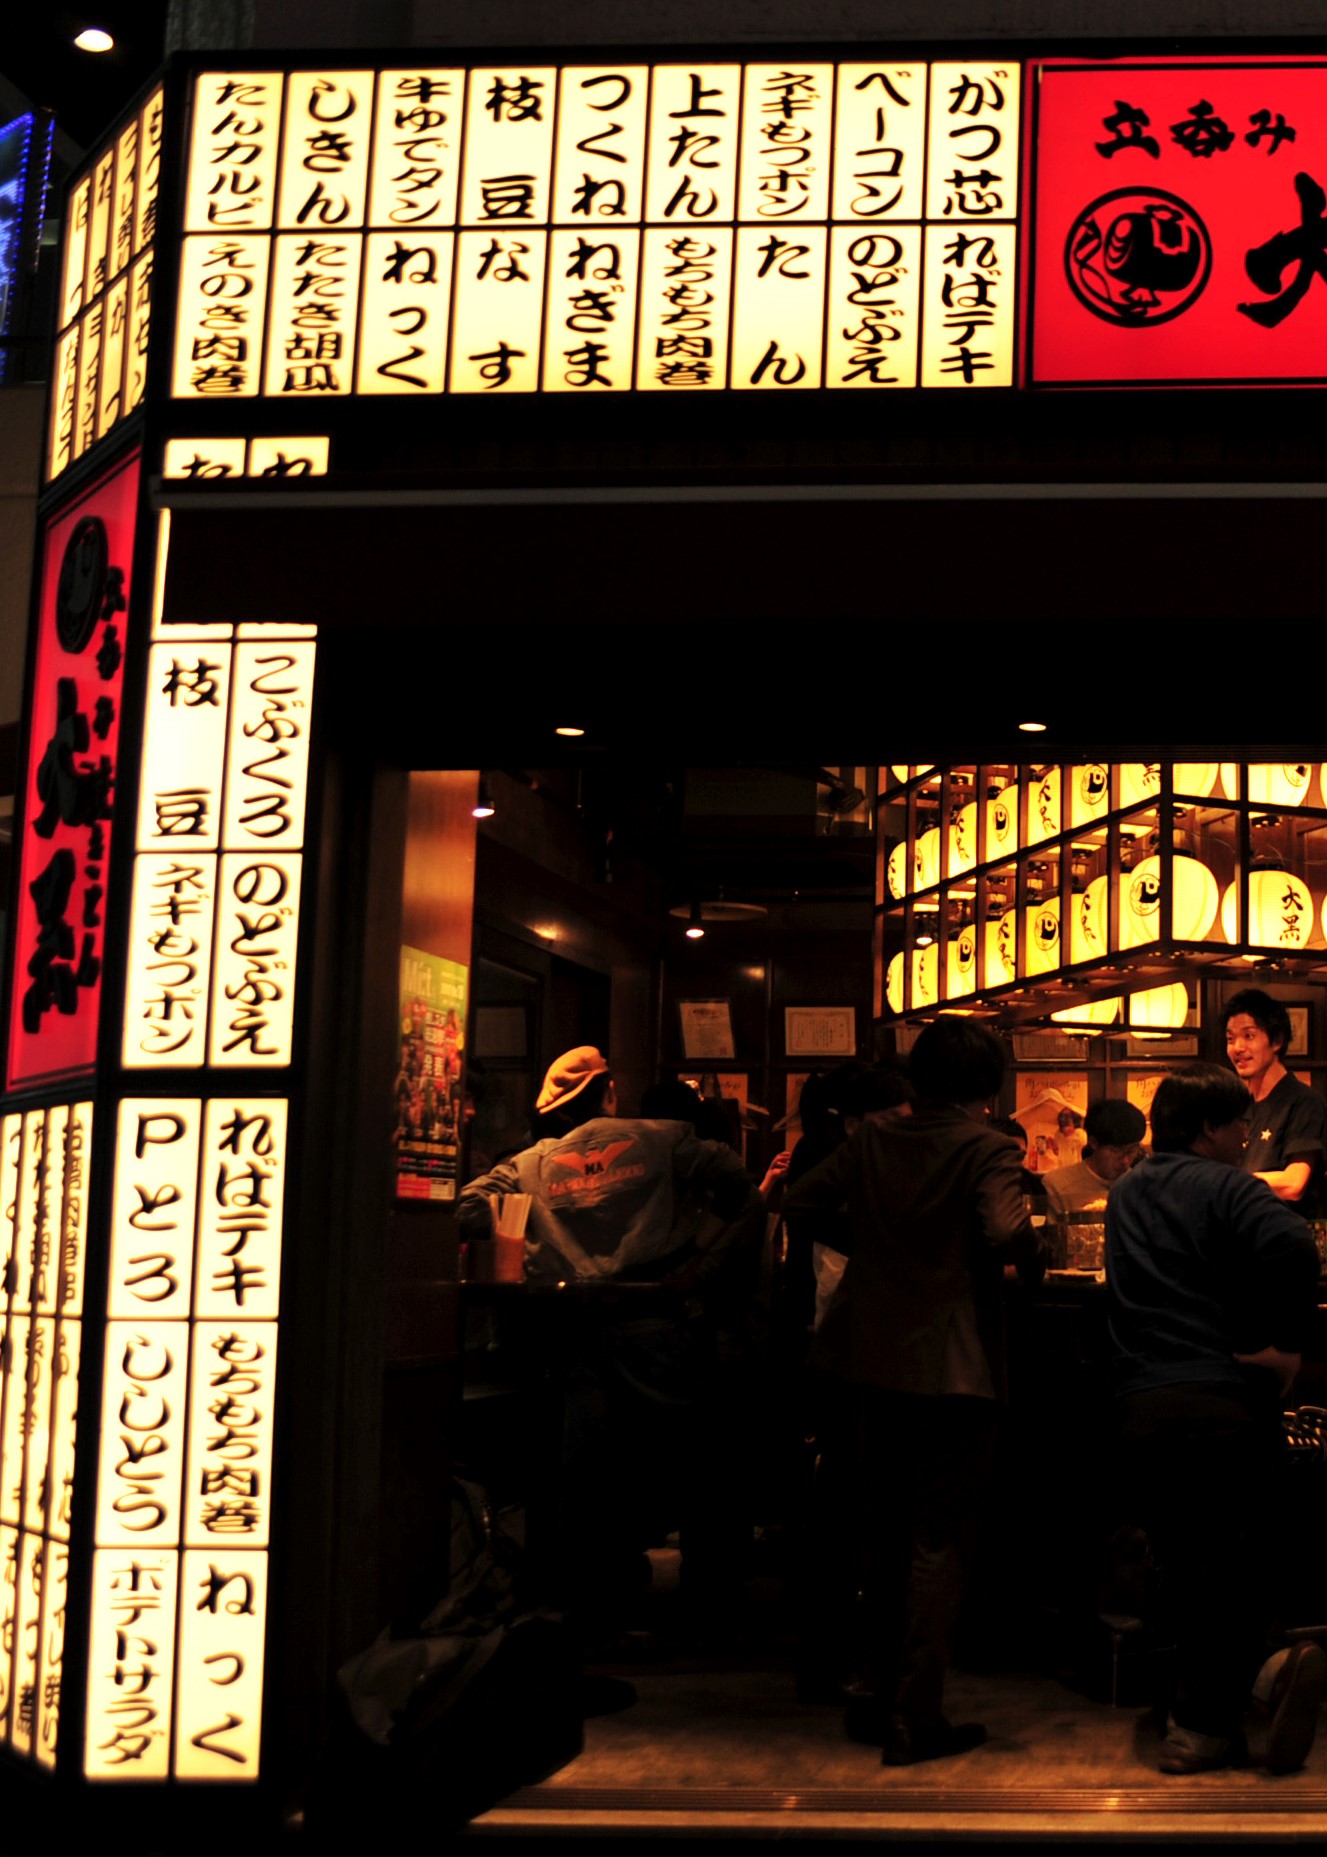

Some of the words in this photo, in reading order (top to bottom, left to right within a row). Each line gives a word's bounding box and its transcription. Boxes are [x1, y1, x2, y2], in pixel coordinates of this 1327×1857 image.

[207, 79, 267, 226] たんカルビ
[295, 79, 358, 225] しきん
[388, 75, 452, 224] 牛ゆでタン
[476, 75, 545, 222] 枝豆
[570, 73, 633, 217] つくね
[663, 72, 727, 219] 上たん
[756, 70, 820, 218] ネギもつポン
[851, 70, 912, 217] ベーコン
[942, 69, 1009, 216] がつ芯
[1094, 98, 1296, 160] 立呑み
[190, 242, 256, 393] えのき肉巻
[281, 239, 347, 393] たたき胡瓜
[375, 240, 439, 389] ねっく
[468, 237, 531, 390] なす
[563, 236, 625, 388] ねぎま
[654, 235, 718, 386] もちもち肉巻
[749, 234, 811, 386] たん
[841, 233, 909, 384] のどぶえ
[939, 231, 1002, 385] ればテキ
[151, 657, 223, 838] 枝豆
[237, 655, 301, 839] こぶくろ
[22, 677, 90, 1034] 大黒
[1279, 885, 1304, 942] 大黒
[142, 863, 205, 1055] ネギもつポン
[221, 862, 293, 1056] のどぶえ
[123, 1112, 187, 1303] Pとろ
[211, 1107, 277, 1307] ればテキ
[110, 1334, 174, 1533] ししとう
[200, 1333, 265, 1534] もちもち肉巻
[190, 1564, 256, 1765] ねっく
